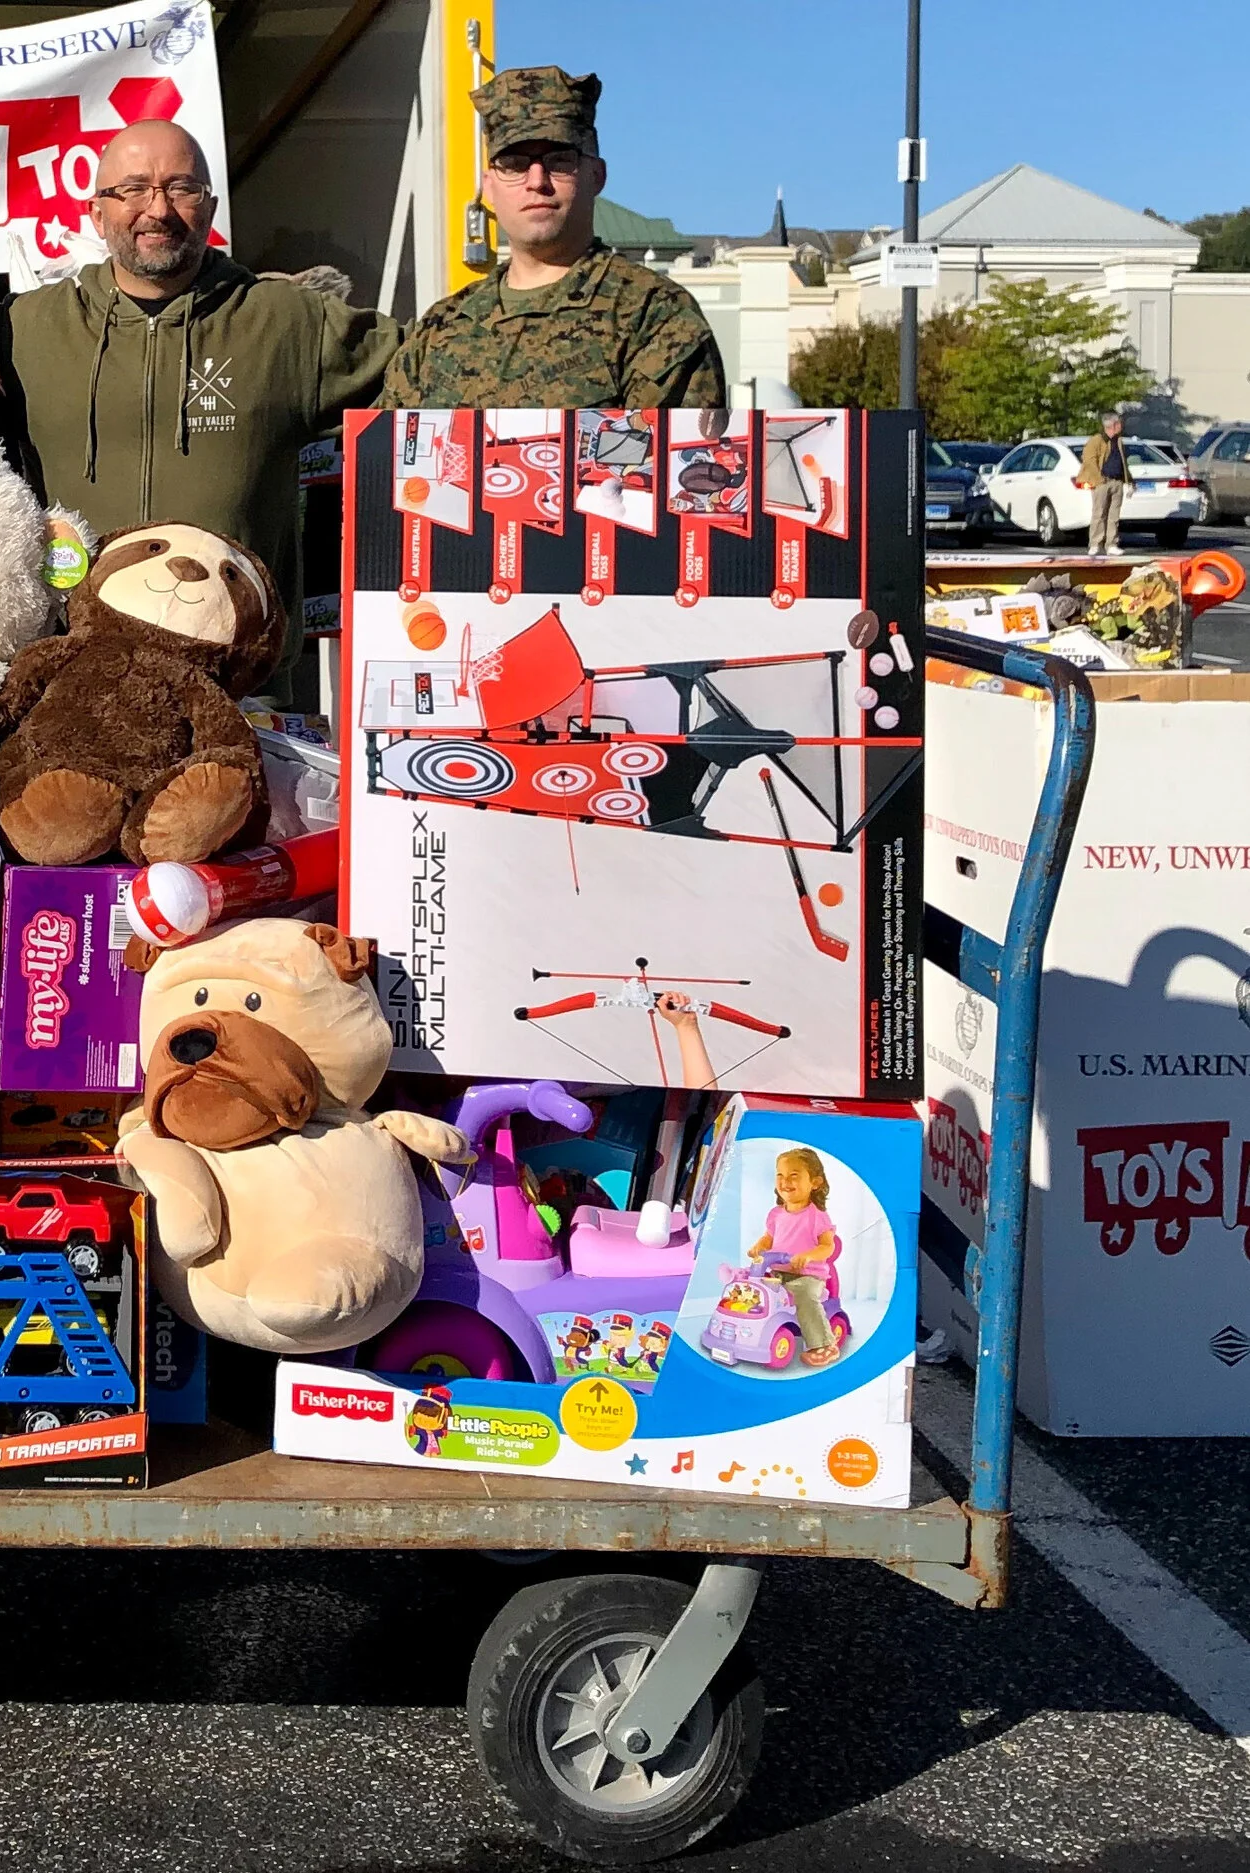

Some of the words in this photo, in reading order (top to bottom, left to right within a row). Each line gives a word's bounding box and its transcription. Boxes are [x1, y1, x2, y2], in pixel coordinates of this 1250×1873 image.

[17, 144, 106, 201] TO
[205, 414, 236, 426] VALLEY
[411, 517, 421, 578] BASKETBALL
[499, 533, 508, 579] ARCHERY
[507, 520, 517, 579] CHALLENGE
[591, 531, 600, 580] BASEBALL
[685, 530, 695, 582] FOOTBALL
[600, 554, 609, 580] TOSS
[694, 555, 704, 582] TOSS
[781, 540, 791, 584] HOCKEY
[791, 539, 800, 584] TRAINER
[405, 588, 417, 596] 1
[496, 588, 508, 598] 2
[587, 590, 600, 600] 3
[682, 592, 695, 602] 4
[778, 593, 792, 603] 5
[882, 844, 892, 871] Action!
[1084, 845, 1160, 873] NEW,
[894, 857, 906, 892] Throwing
[882, 872, 894, 908] Non-Stop
[894, 893, 903, 908] and
[82, 893, 95, 919] host
[882, 909, 892, 920] for
[58, 922, 71, 943] as
[412, 810, 428, 1051] SPORTSPLEX
[882, 921, 894, 948] System
[894, 908, 906, 942] Shooting
[79, 918, 94, 974] sleepover
[430, 831, 446, 1051] MULTI-GAME
[894, 943, 903, 961] Your
[882, 950, 894, 979] Gaming
[894, 962, 903, 991] Practice
[905, 953, 915, 979] Shown
[882, 980, 891, 1002] Great
[894, 997, 903, 1010] On
[905, 980, 917, 1019] Everything
[882, 1009, 891, 1017] in
[894, 1011, 905, 1040] Training
[882, 1018, 891, 1045] Games
[905, 1020, 915, 1037] with
[882, 1046, 891, 1067] Great
[895, 1041, 905, 1059] your
[905, 1037, 916, 1075] Complete
[894, 1059, 903, 1074] Get
[1078, 1053, 1135, 1077] U.S.
[1091, 1140, 1214, 1208] TOYS
[575, 1403, 597, 1416] Try
[601, 1405, 623, 1416] Me!
[6, 1433, 137, 1460] TRANSPORTER
[465, 1436, 495, 1448] Music
[497, 1438, 535, 1450] Parade
[476, 1448, 520, 1460] Ride-On
